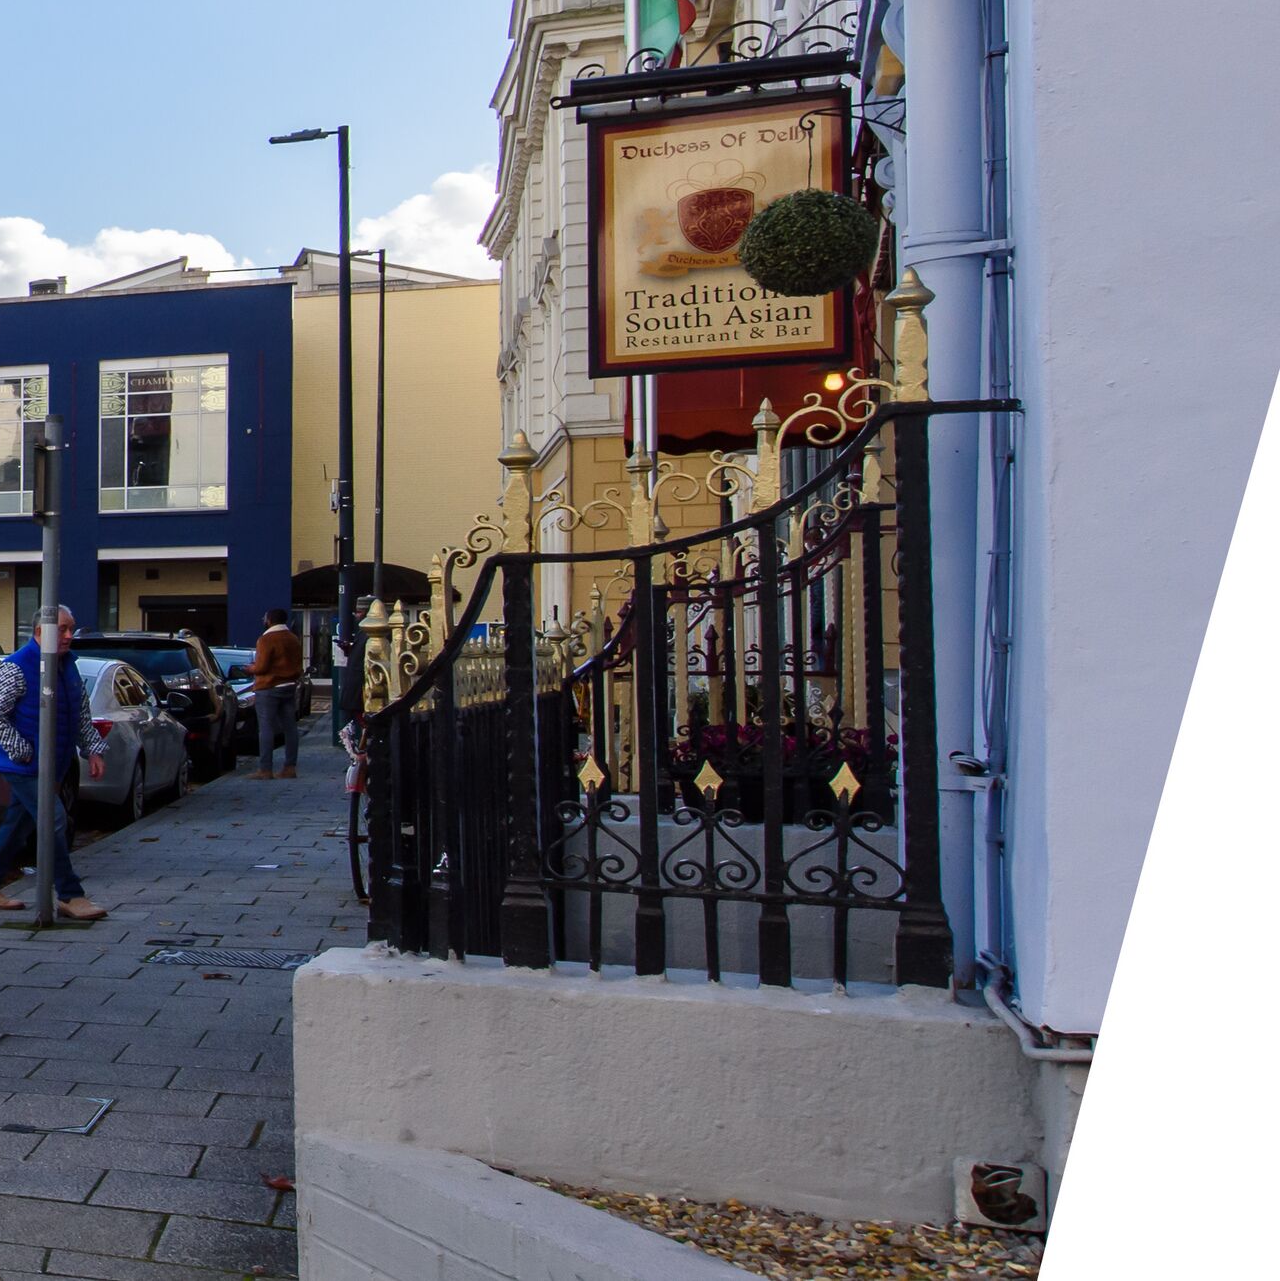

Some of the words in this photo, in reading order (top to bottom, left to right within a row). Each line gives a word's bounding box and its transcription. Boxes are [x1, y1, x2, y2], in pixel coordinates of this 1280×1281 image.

[619, 139, 710, 159] Duchess
[720, 131, 745, 148] Of
[625, 282, 779, 310] Tradition
[625, 307, 711, 334] South
[724, 303, 812, 326] Asian
[626, 329, 740, 349] Restaurant
[749, 326, 764, 339] &
[776, 324, 812, 338] Bar
[130, 375, 197, 386] CHAMPAGNE
